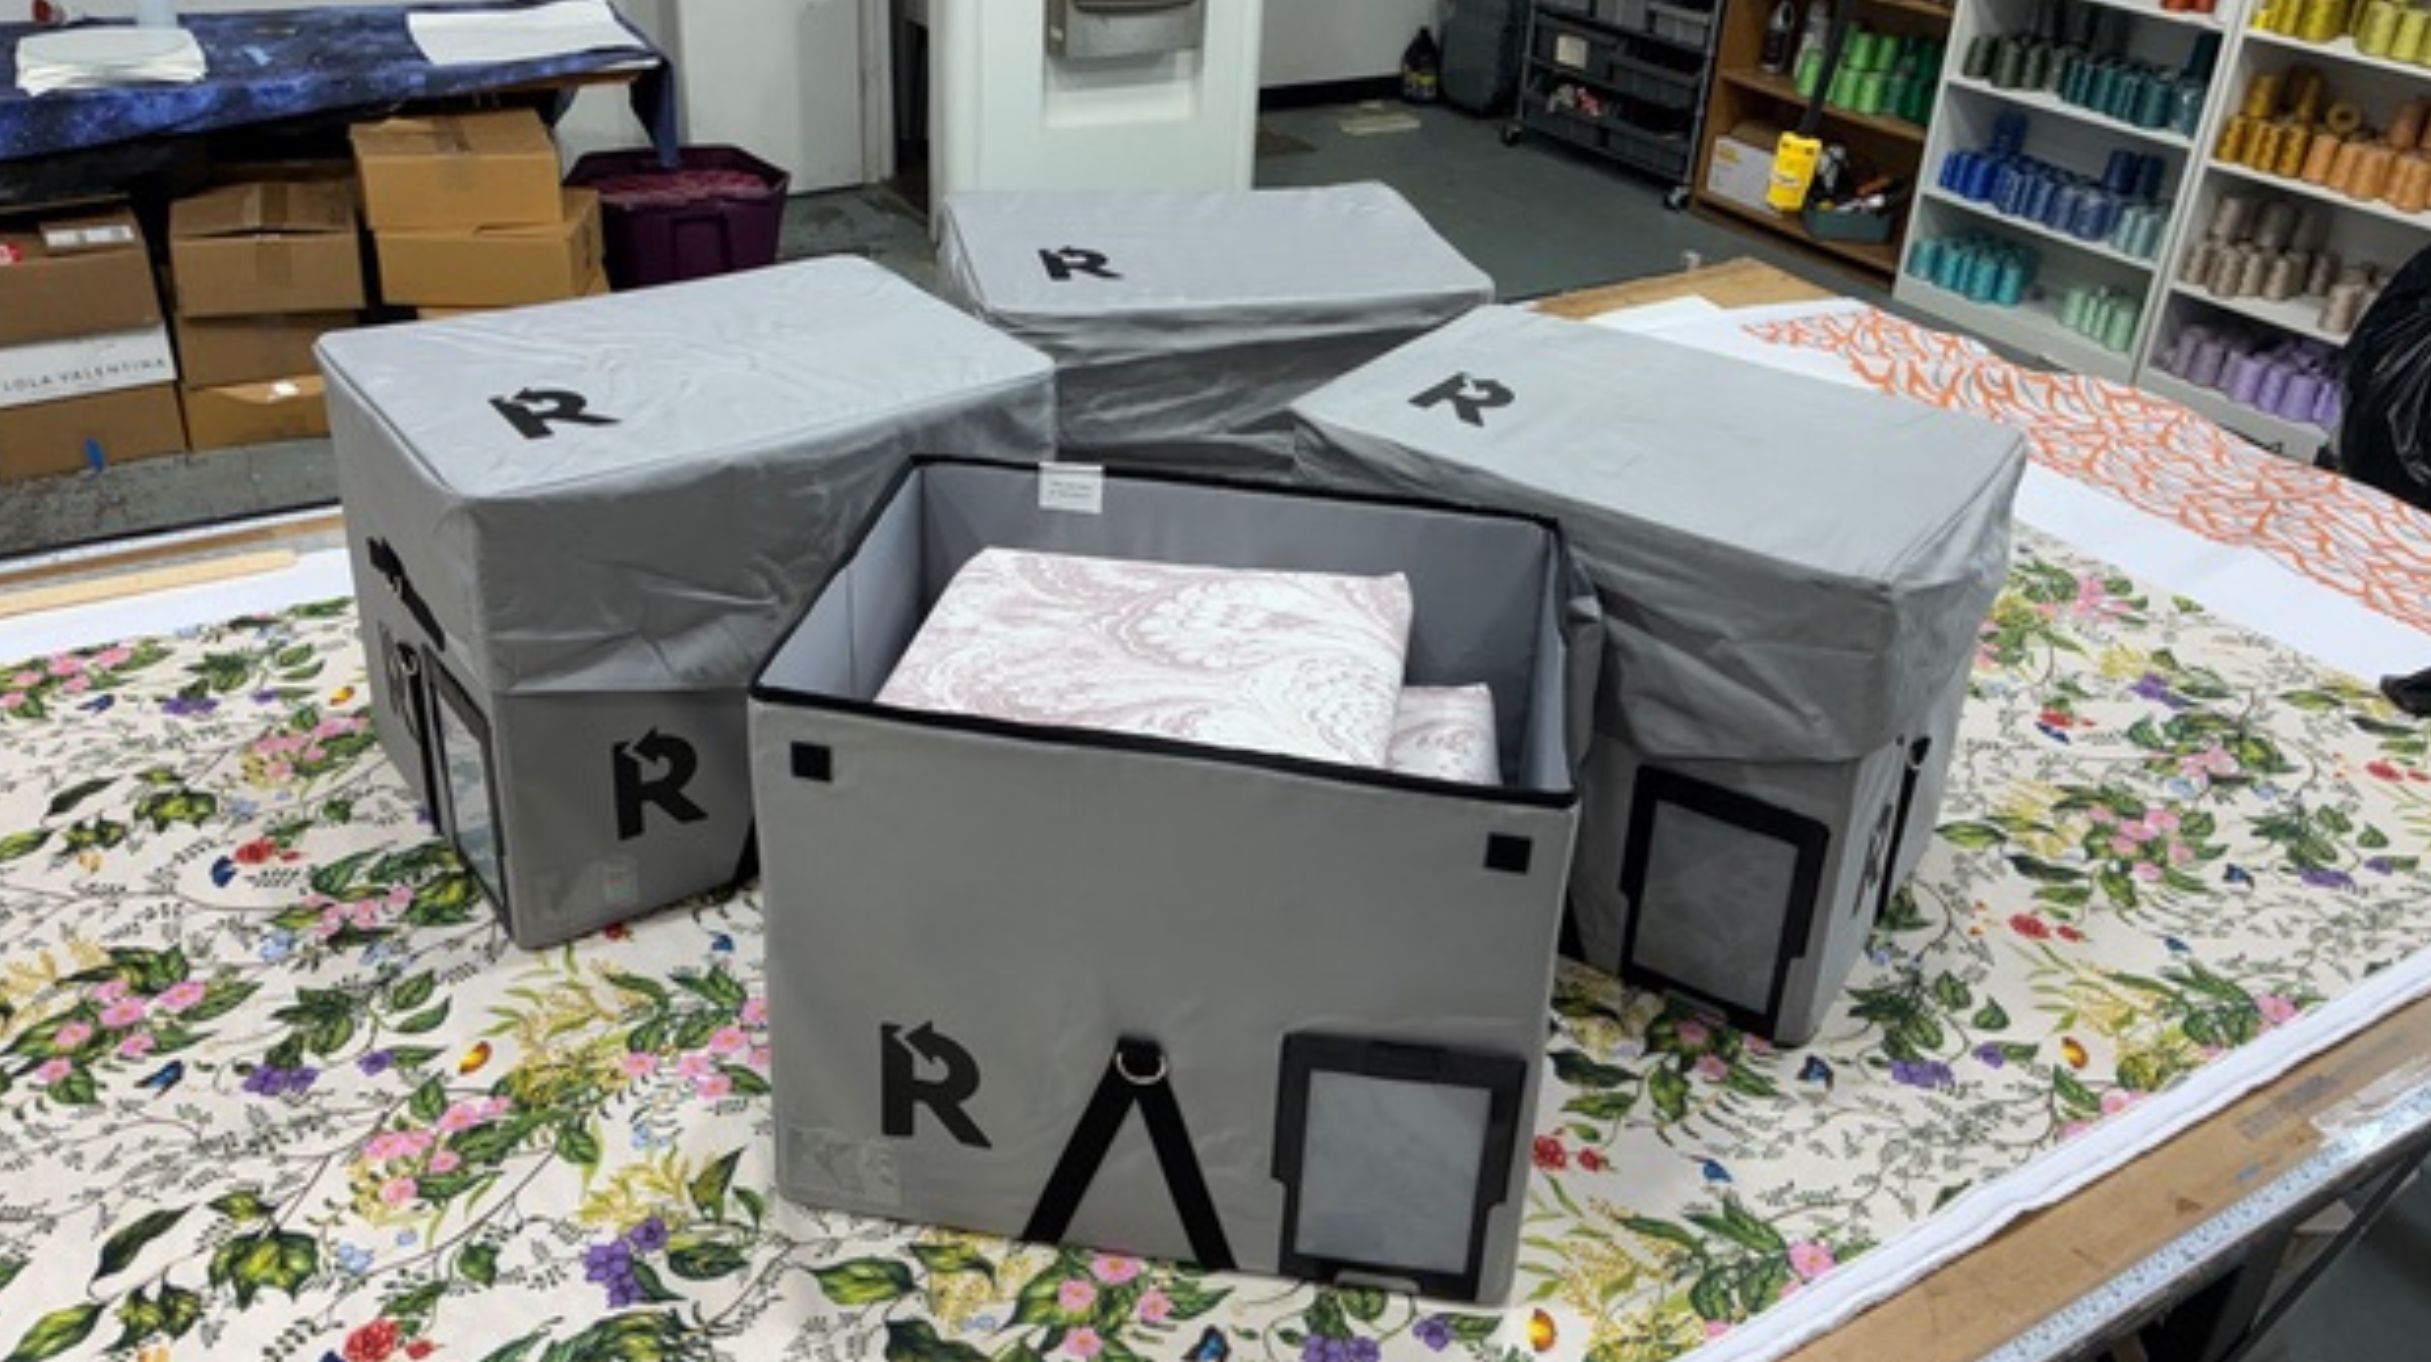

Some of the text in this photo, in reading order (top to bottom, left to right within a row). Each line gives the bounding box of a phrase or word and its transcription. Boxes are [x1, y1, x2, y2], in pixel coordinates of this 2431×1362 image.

[1038, 245, 1123, 282] R
[3, 357, 165, 391] LOLA VALENTINA
[1408, 371, 1516, 428] R
[489, 387, 621, 440] R
[611, 727, 709, 842] R
[880, 1020, 992, 1149] R
